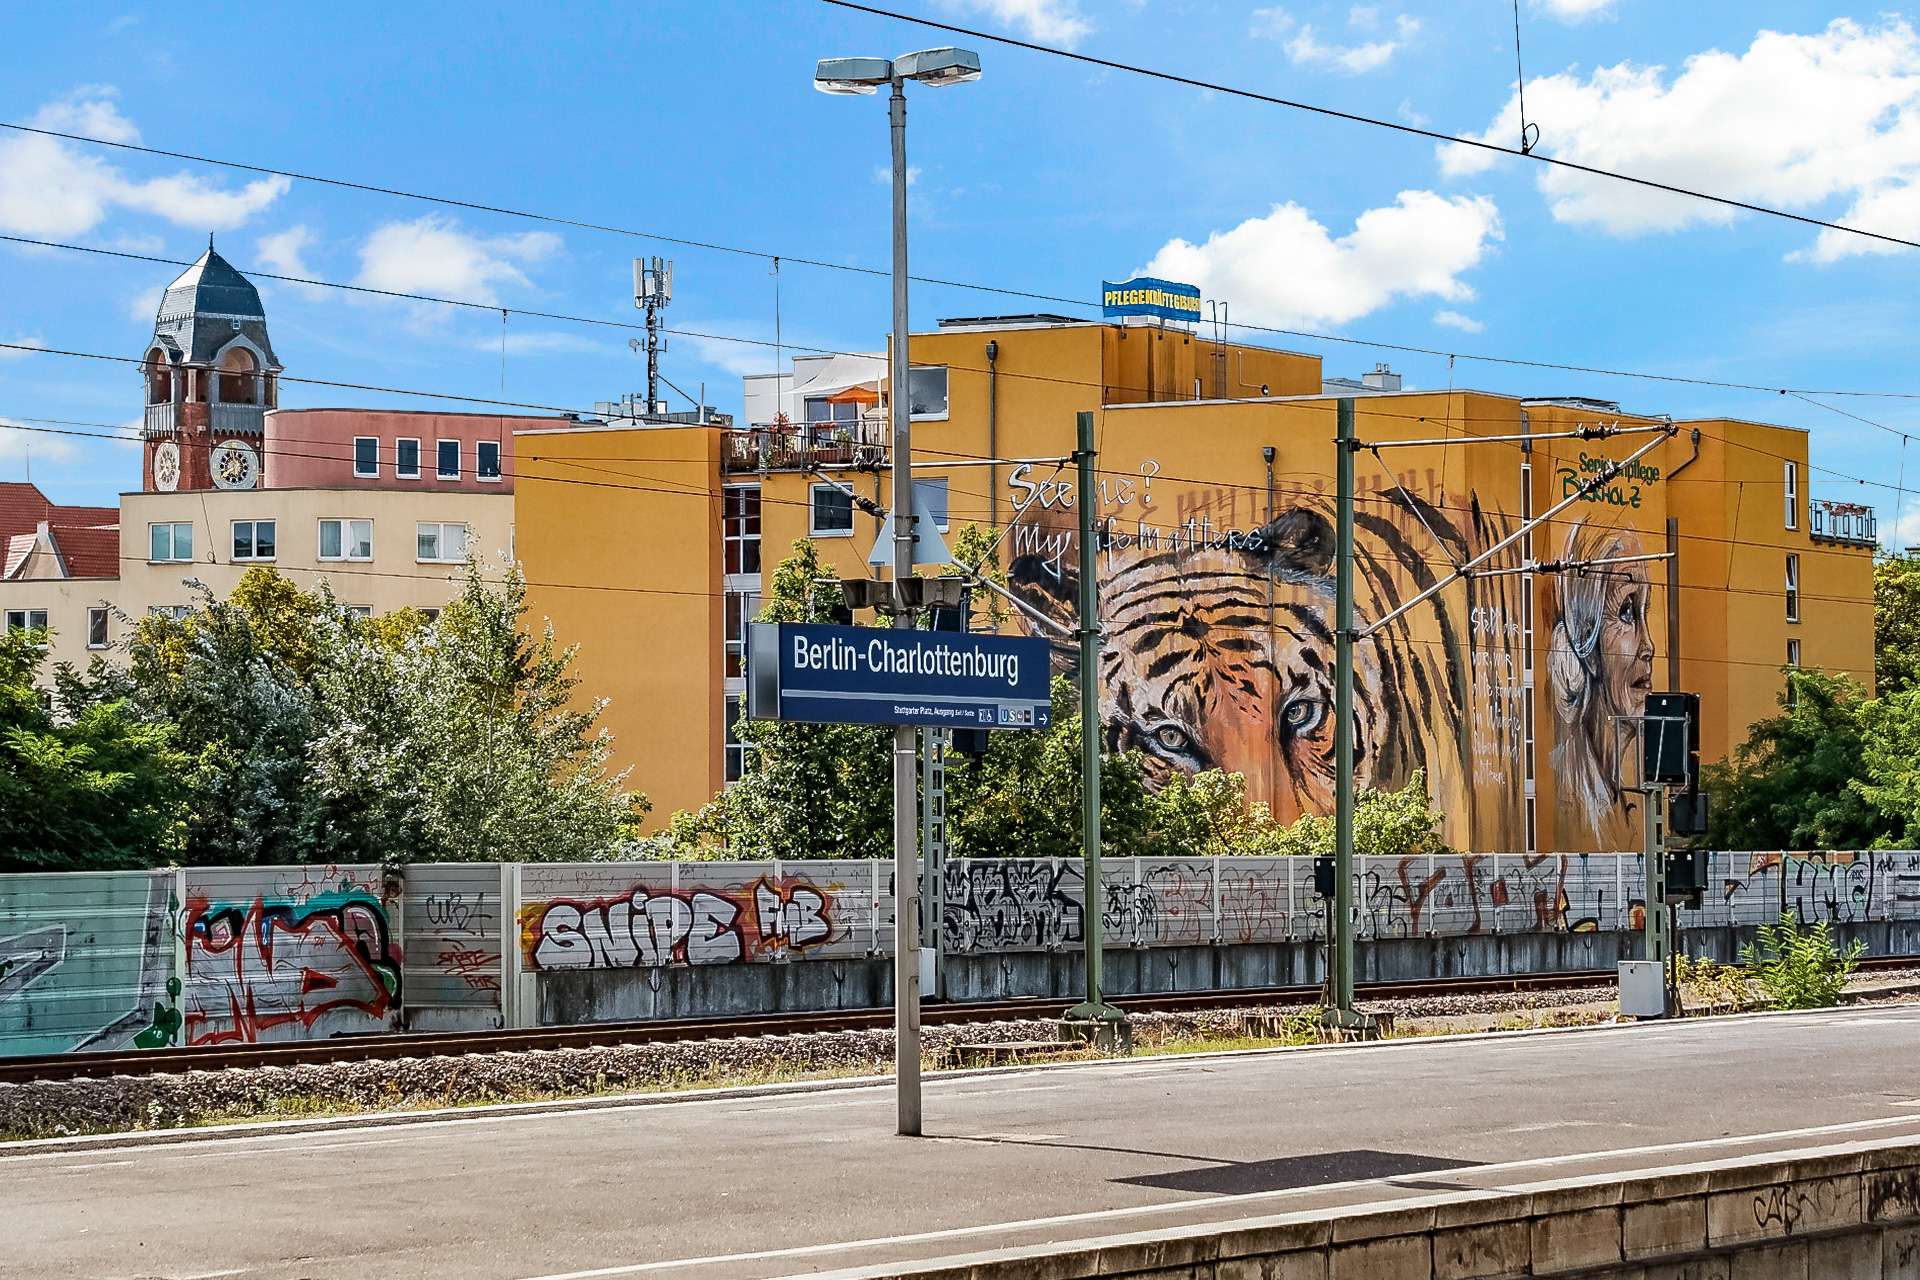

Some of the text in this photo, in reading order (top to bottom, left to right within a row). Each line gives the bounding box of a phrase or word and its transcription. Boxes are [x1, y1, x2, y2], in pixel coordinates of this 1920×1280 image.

[1008, 463, 1076, 511] See
[1579, 452, 1660, 486] Senienpflege
[1014, 522, 1071, 584] My
[1074, 515, 1133, 572] ife
[793, 635, 1019, 687] Berlin-Charlottenburg
